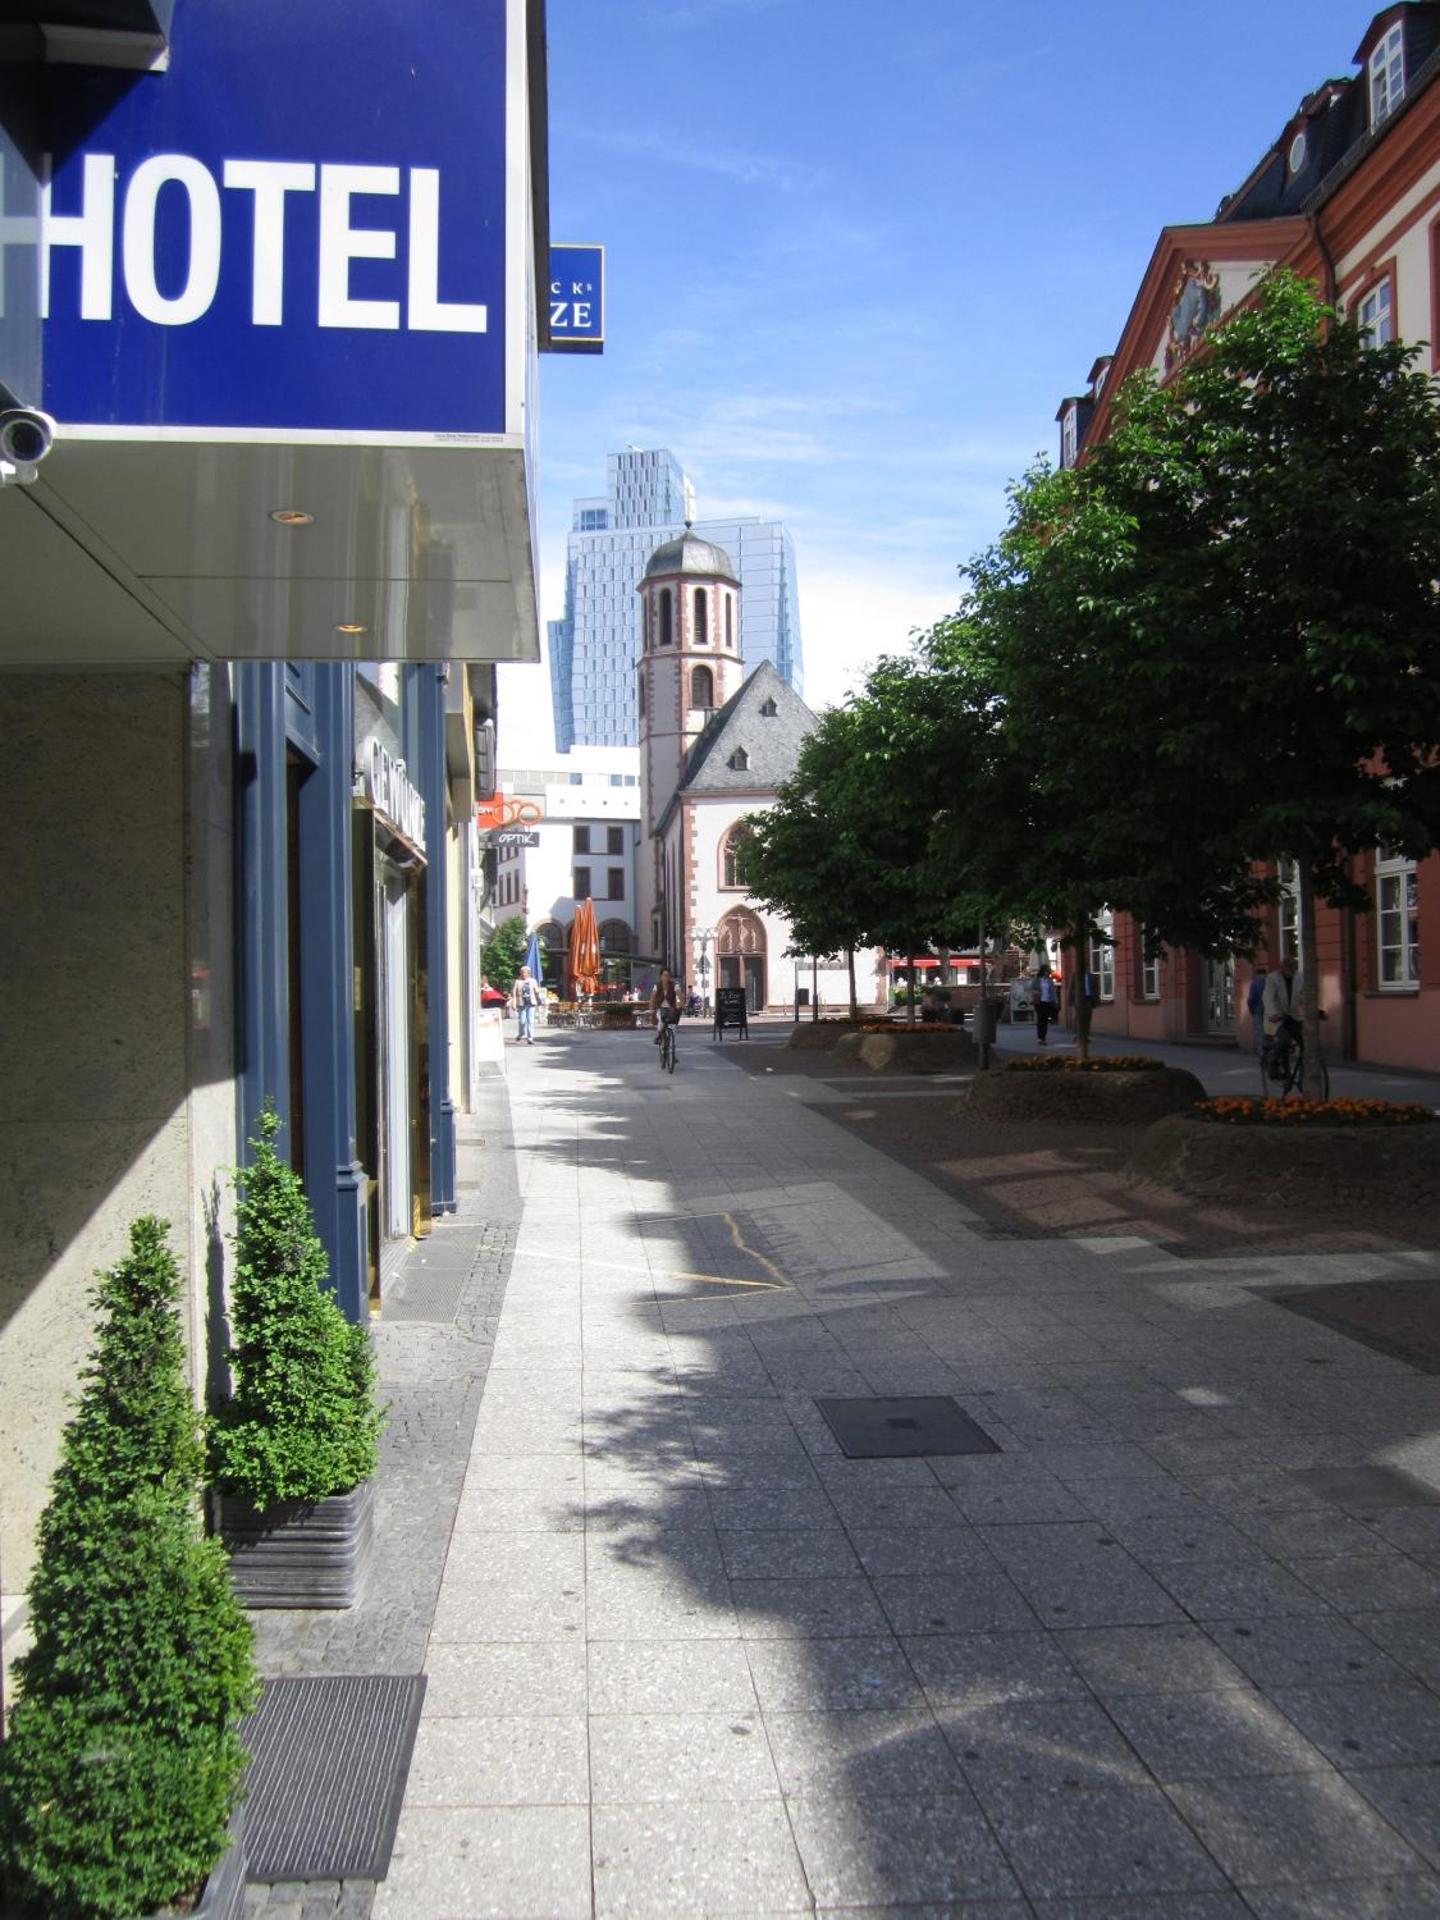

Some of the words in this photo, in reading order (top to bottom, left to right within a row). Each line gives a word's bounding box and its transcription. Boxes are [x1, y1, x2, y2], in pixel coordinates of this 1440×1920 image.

[39, 153, 488, 333] HOTEL
[550, 302, 592, 328] ZE
[498, 833, 535, 845] OPTIK
